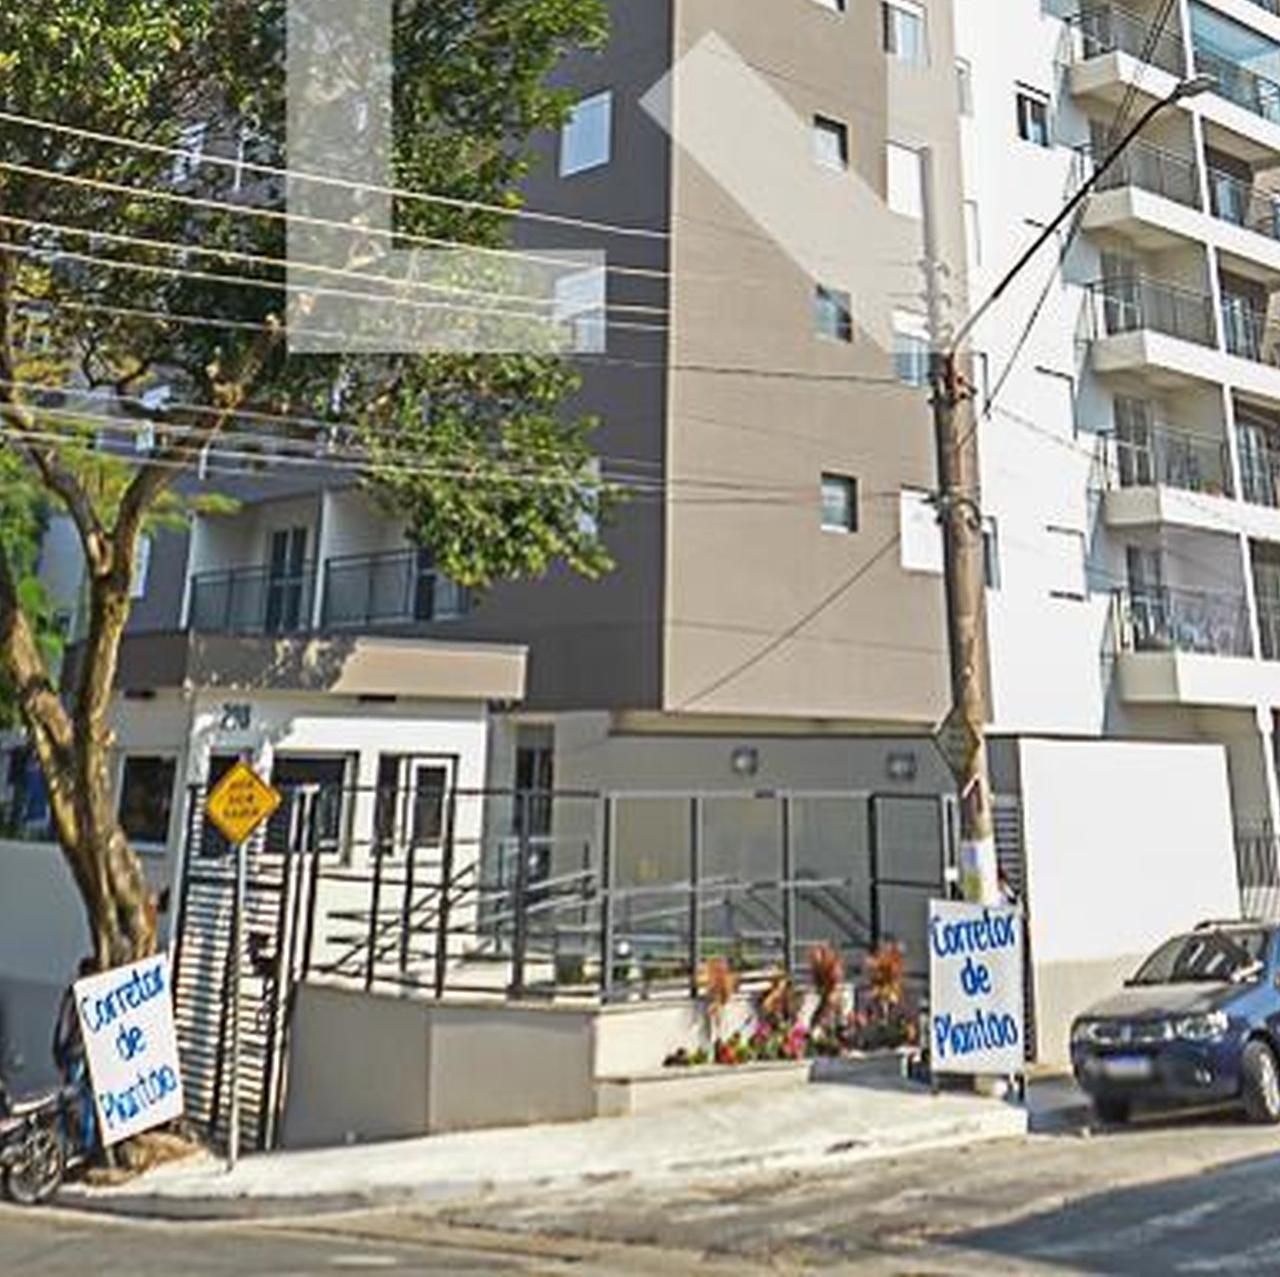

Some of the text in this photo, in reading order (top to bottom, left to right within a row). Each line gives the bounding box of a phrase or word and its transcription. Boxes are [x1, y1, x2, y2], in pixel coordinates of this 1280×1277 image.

[931, 908, 1016, 958] Corretor
[79, 964, 166, 1034] Corretor
[960, 956, 992, 997] de
[115, 1024, 147, 1062] de
